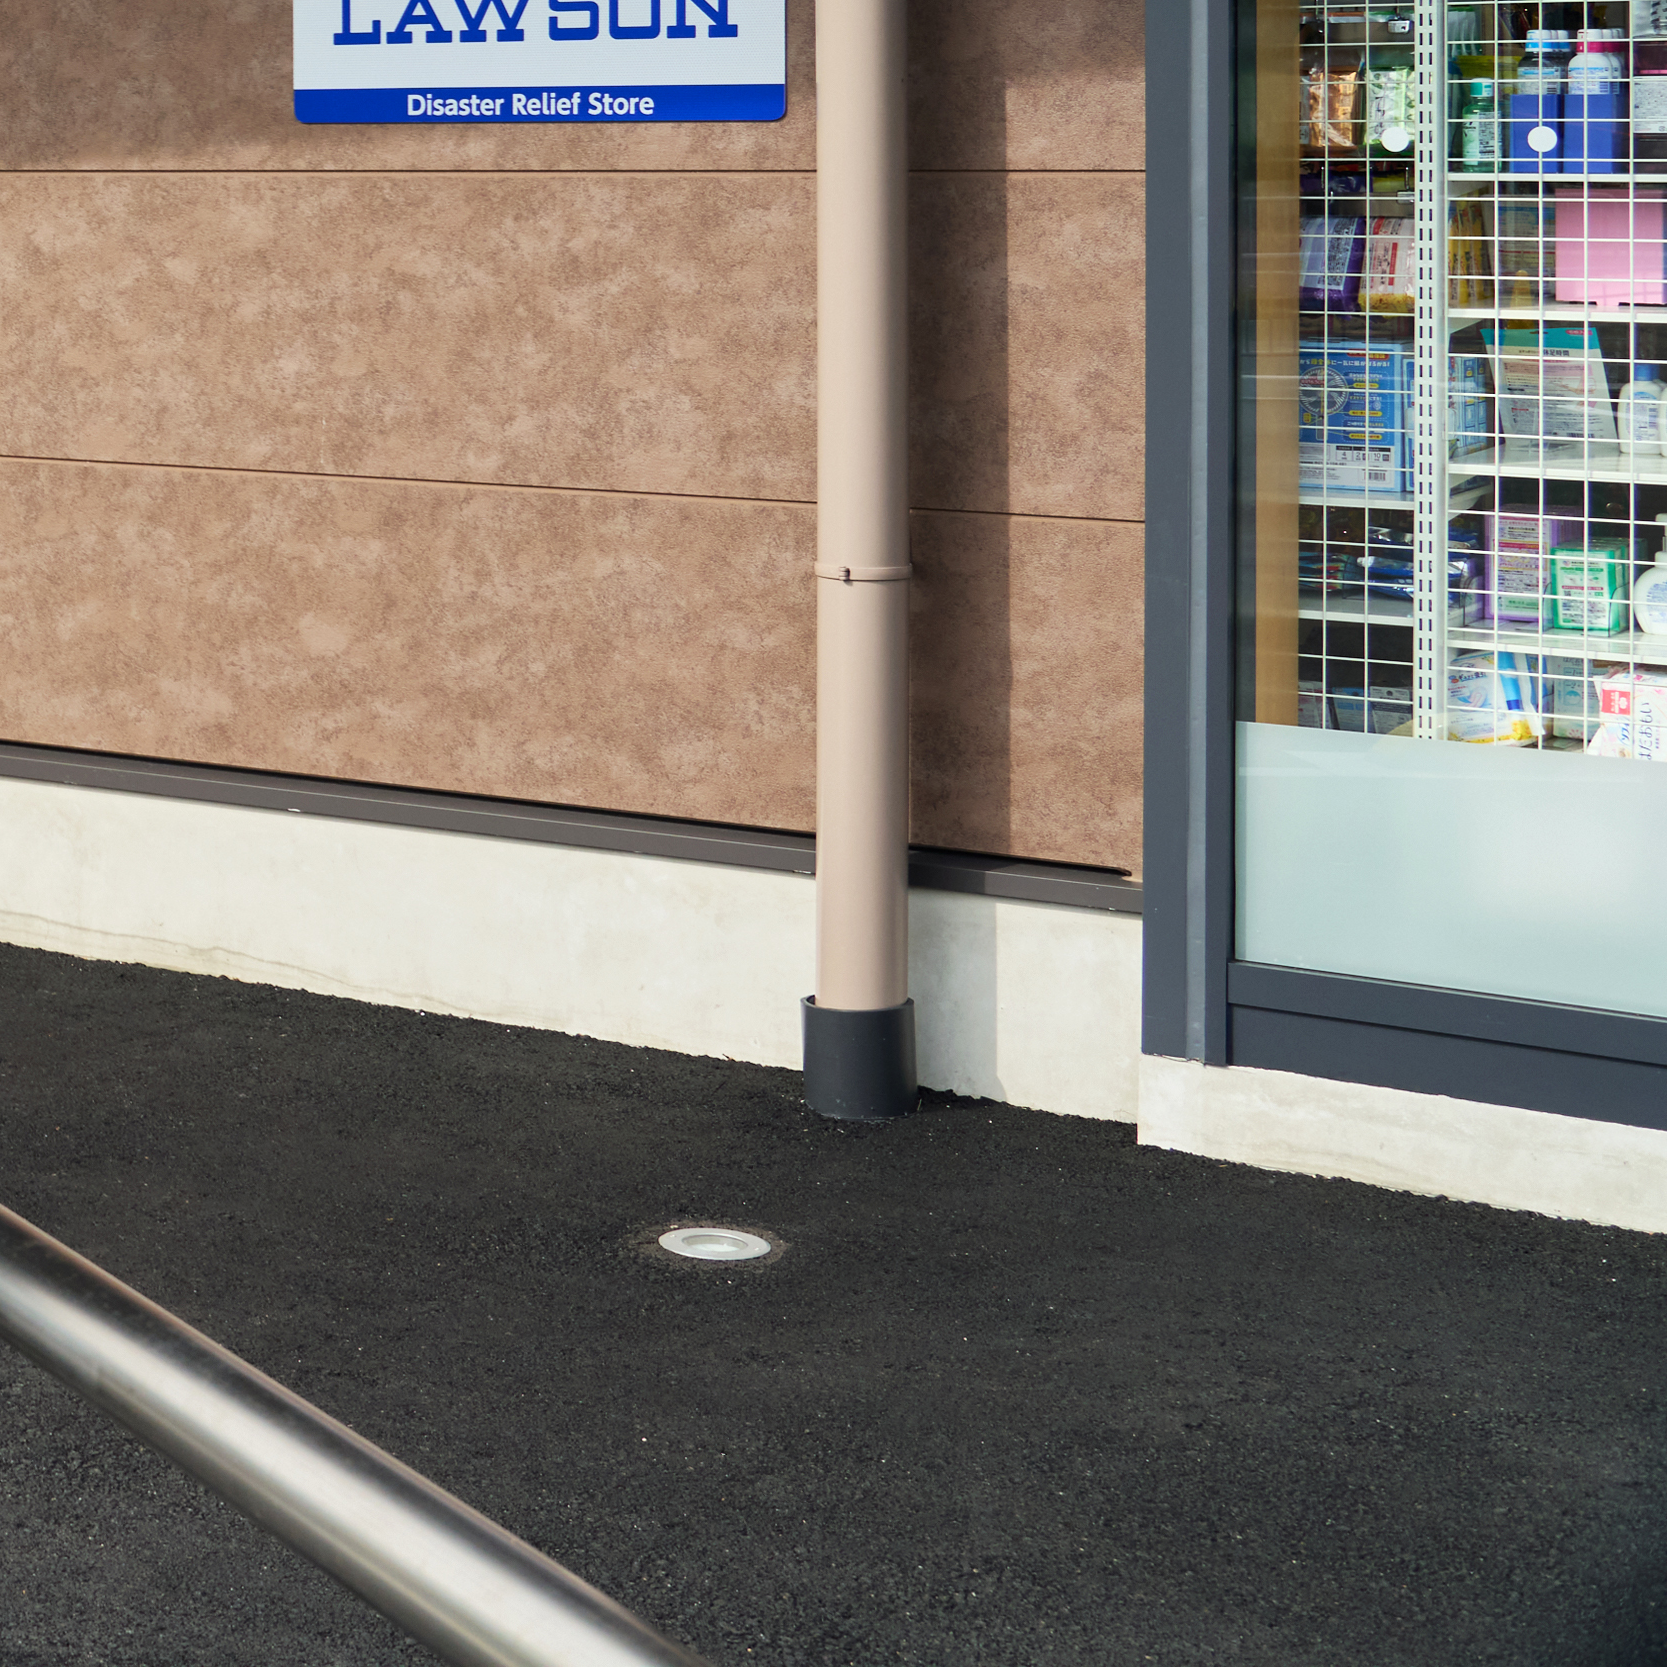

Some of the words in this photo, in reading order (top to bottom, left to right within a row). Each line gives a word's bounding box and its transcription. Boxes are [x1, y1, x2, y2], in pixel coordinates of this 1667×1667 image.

[407, 94, 506, 118] Disaster
[512, 92, 582, 117] Relief
[588, 92, 655, 116] Store
